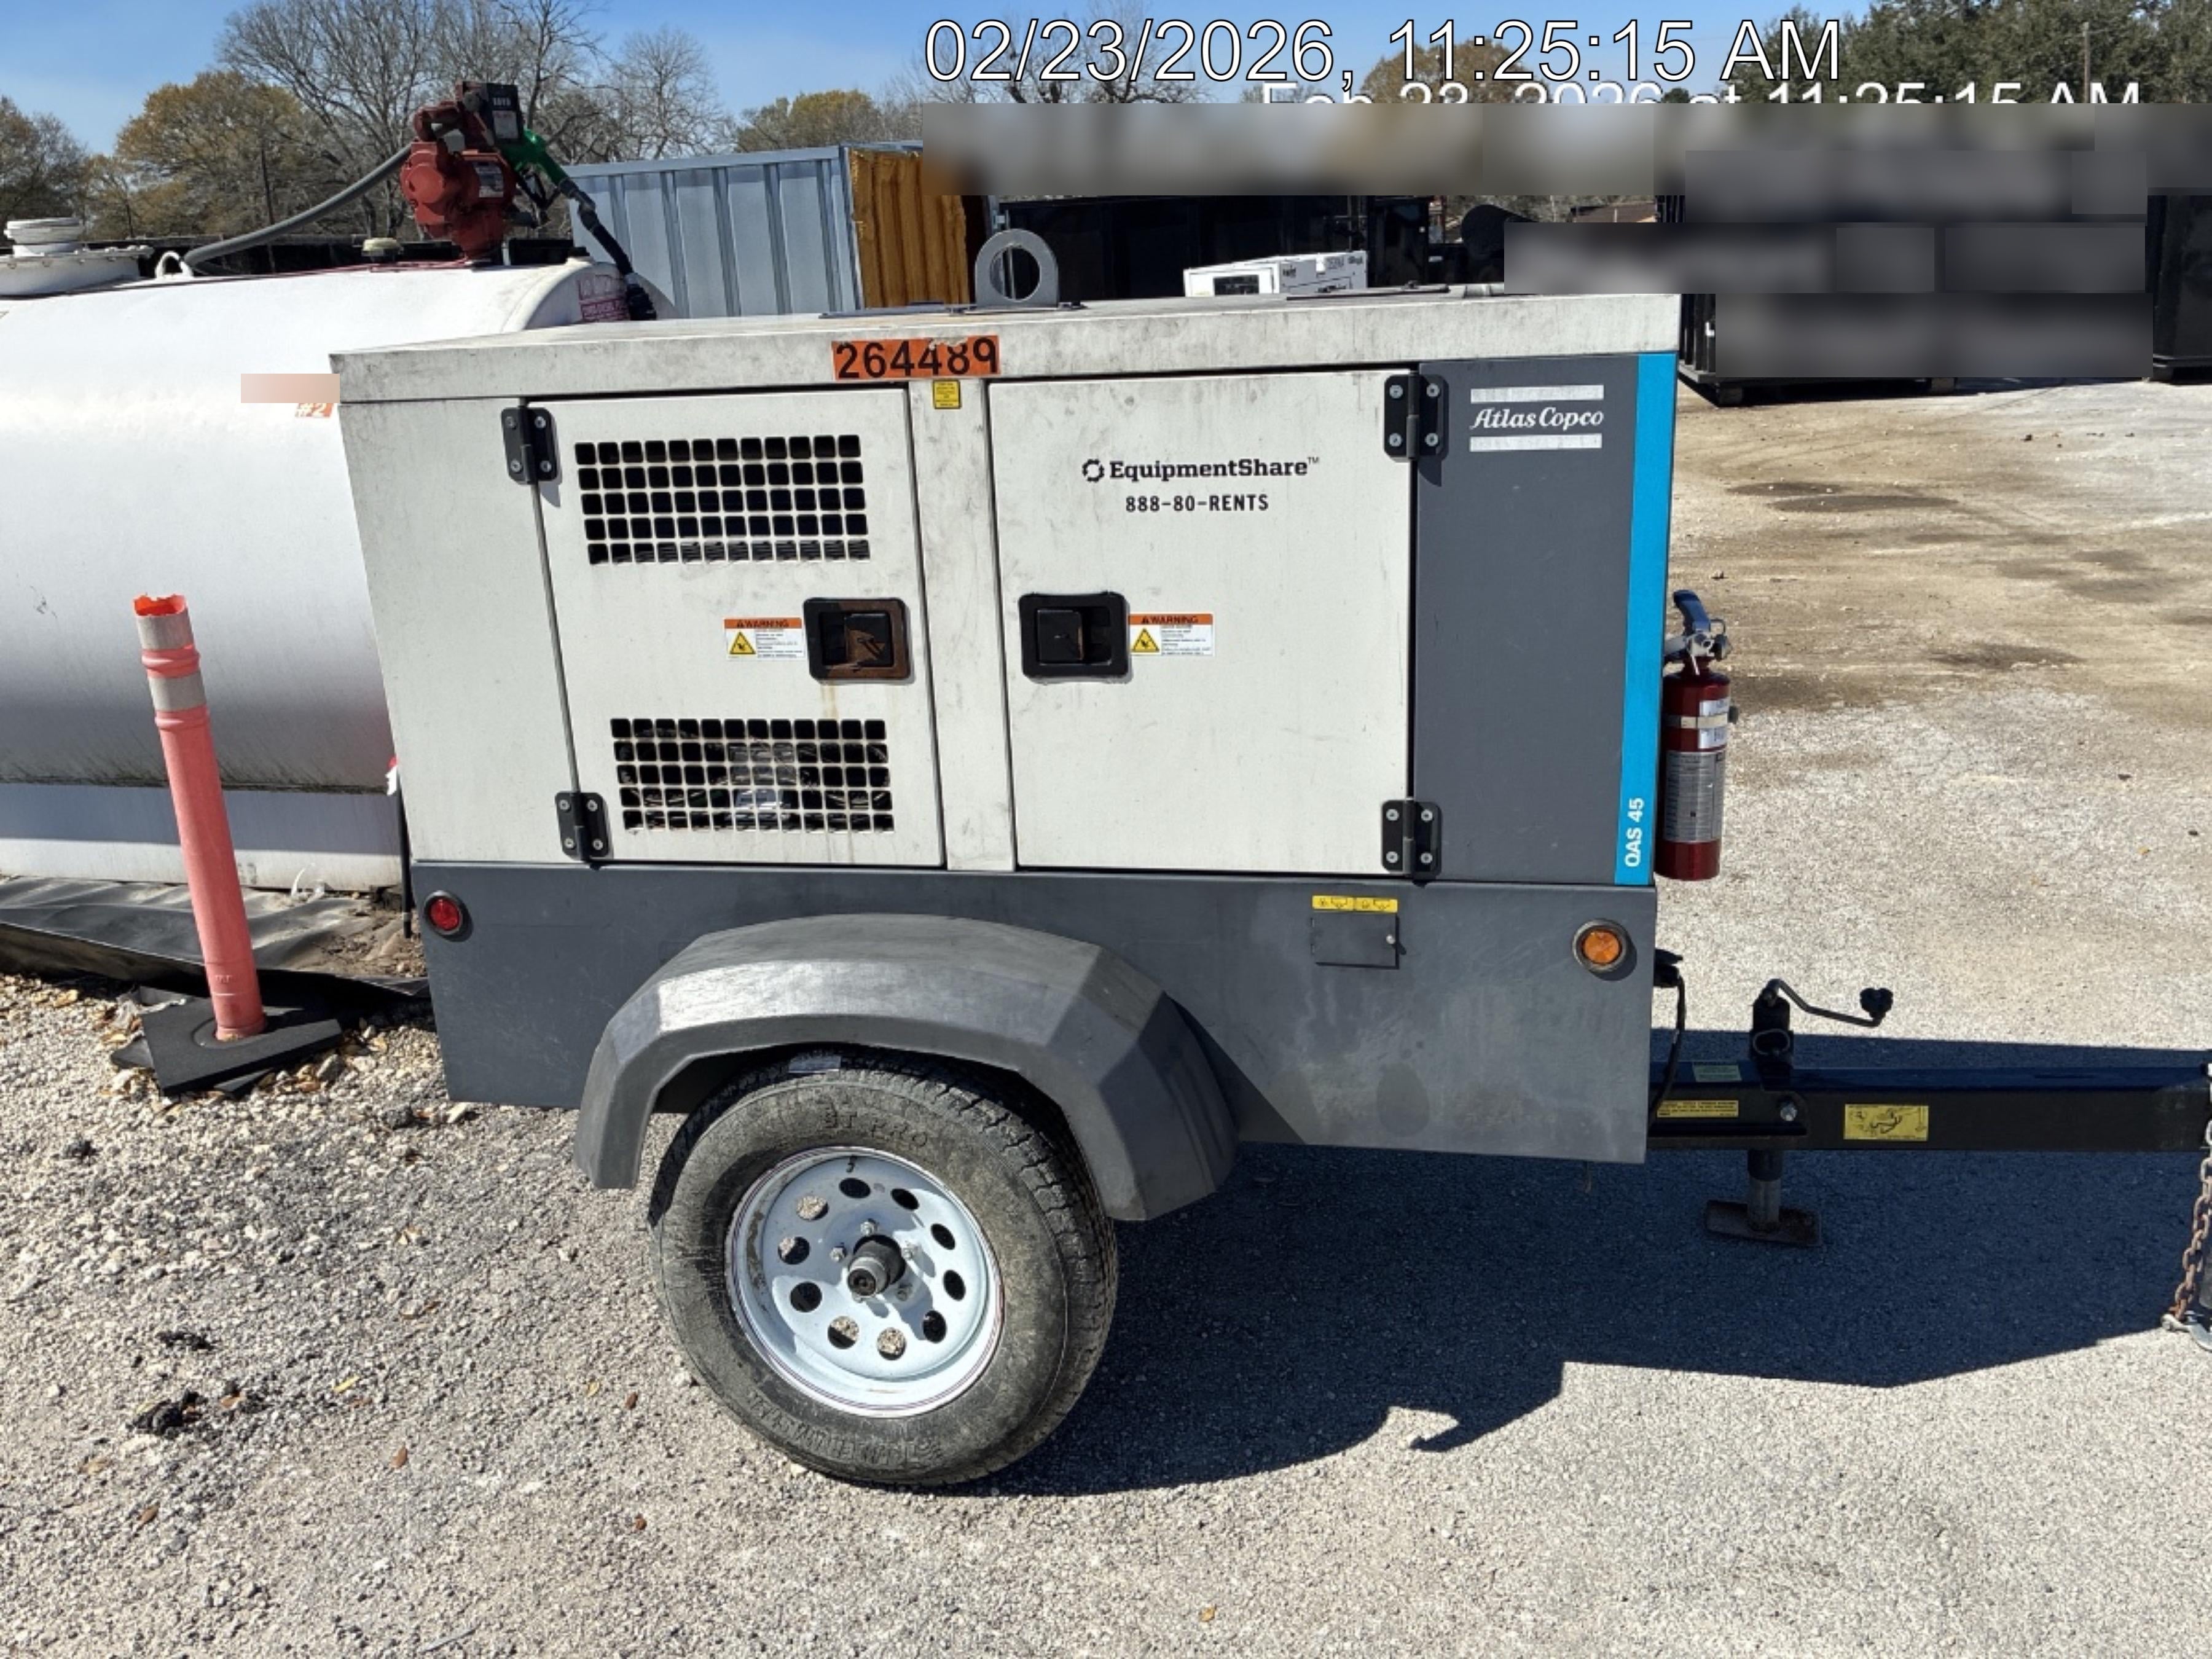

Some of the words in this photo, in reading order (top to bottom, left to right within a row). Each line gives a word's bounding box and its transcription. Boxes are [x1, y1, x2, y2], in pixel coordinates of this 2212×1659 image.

[836, 337, 998, 379] 264489
[1469, 408, 1536, 429] Atlas
[1539, 406, 1604, 431] Copco
[1126, 493, 1269, 512] 888-80-RENTS
[745, 619, 790, 628] WARNING
[1151, 615, 1198, 624] WARNING
[1626, 797, 1645, 823] 45
[1625, 826, 1643, 868] QAS
